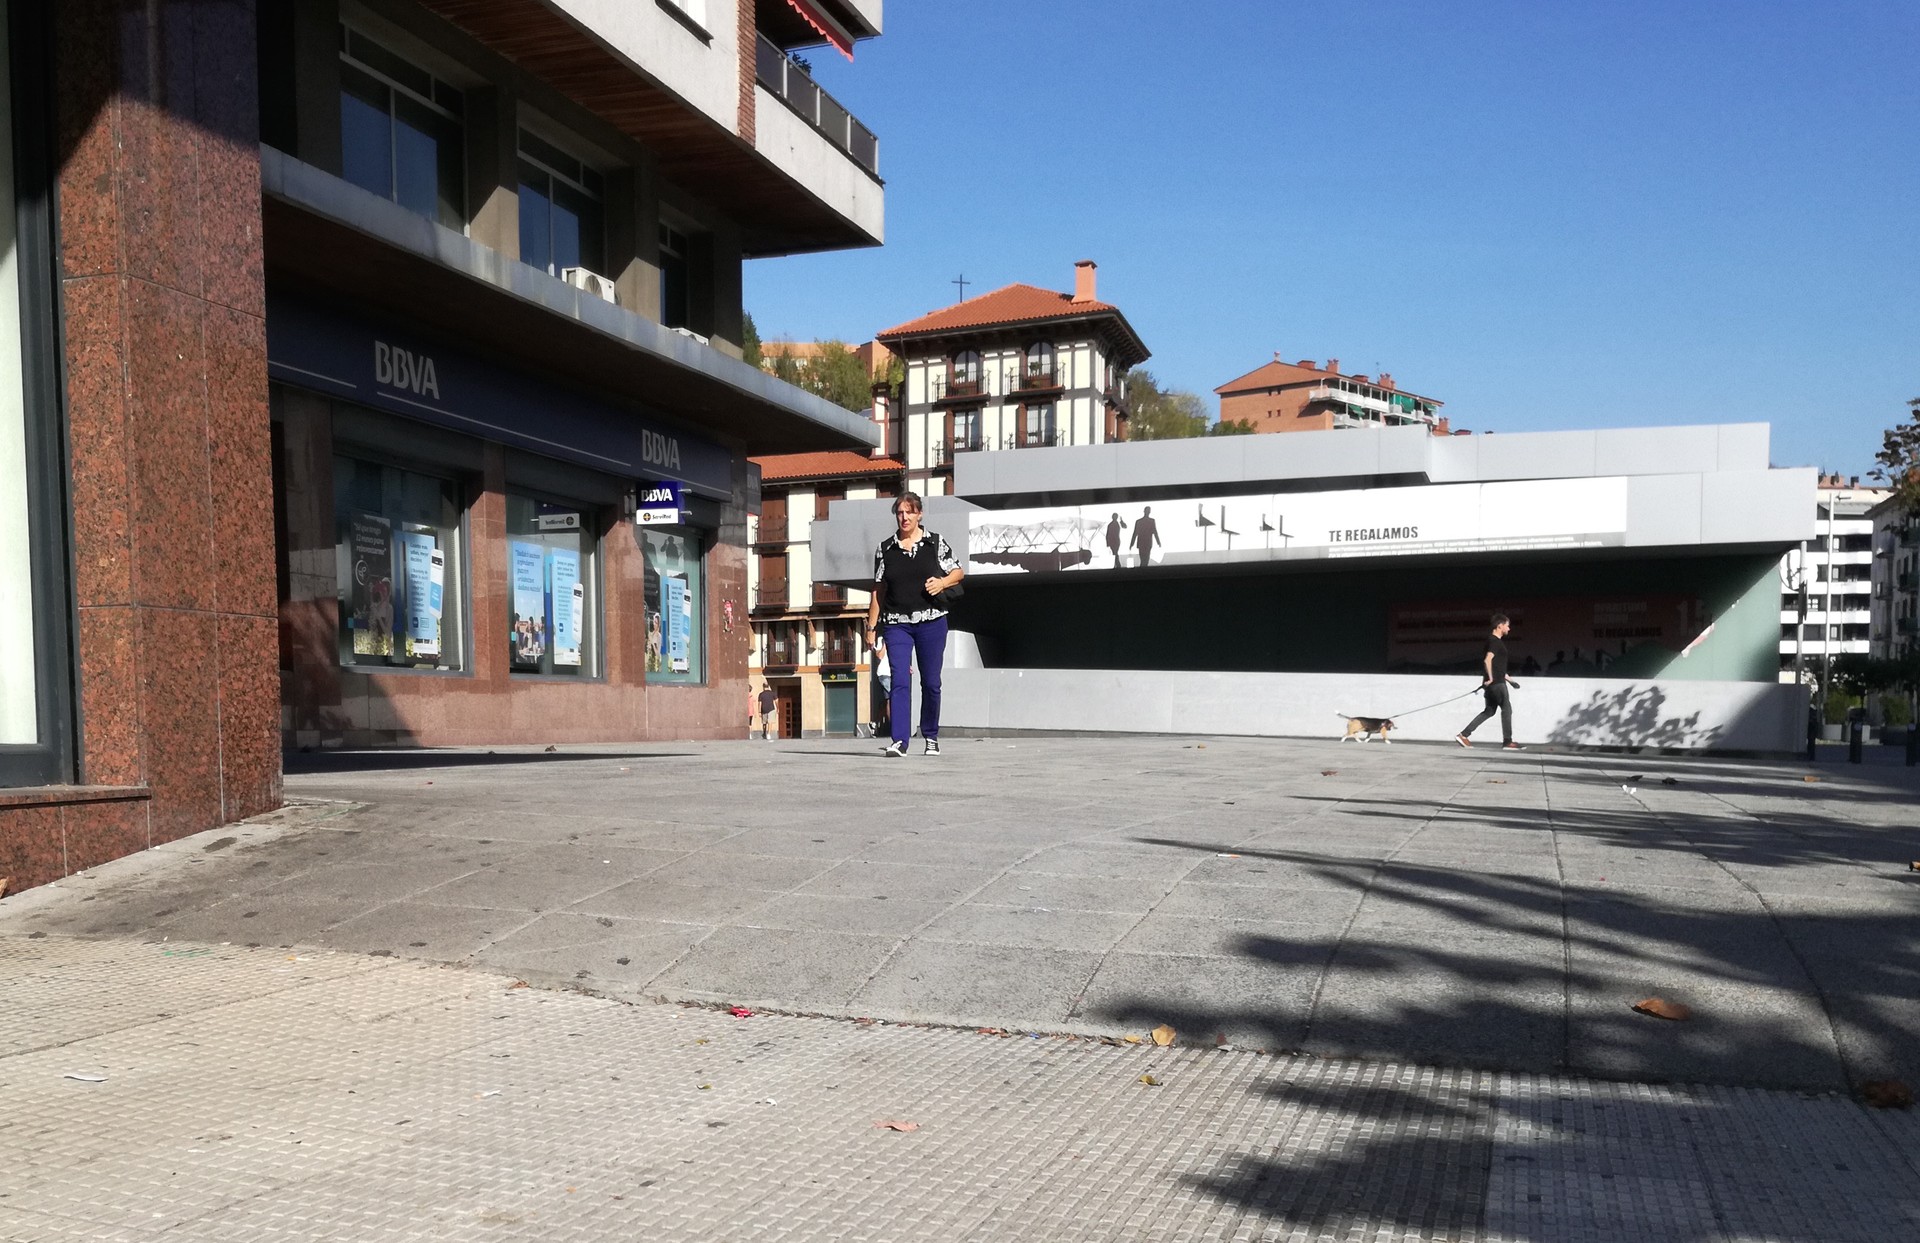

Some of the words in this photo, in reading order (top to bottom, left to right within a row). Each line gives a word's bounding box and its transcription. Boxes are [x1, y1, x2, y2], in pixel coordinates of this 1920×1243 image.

[374, 340, 440, 400] BBVA
[642, 430, 680, 470] BBVA
[641, 488, 673, 502] BBVA
[1329, 530, 1341, 542] TE
[1346, 526, 1418, 540] REGALAMOS
